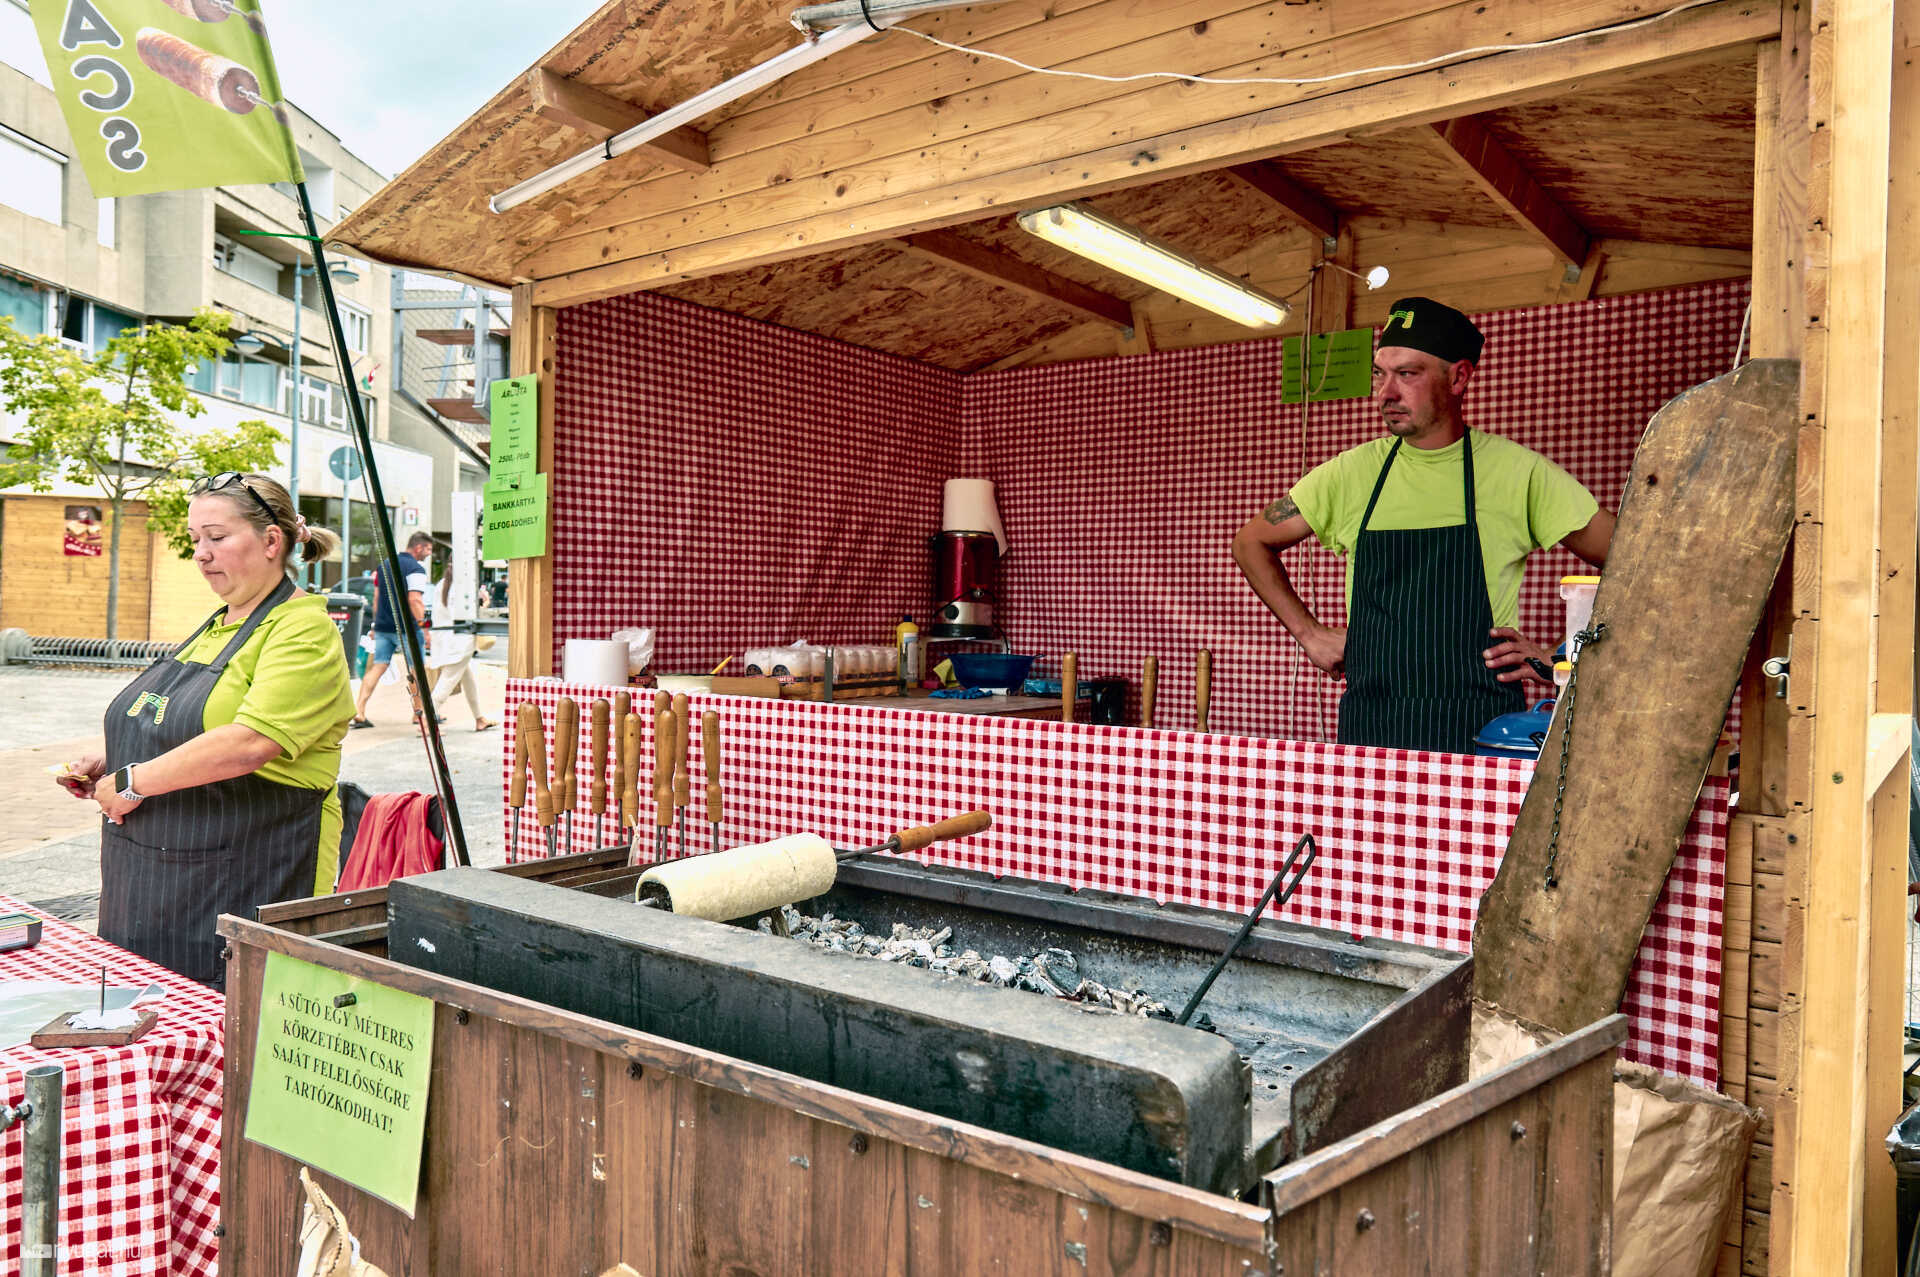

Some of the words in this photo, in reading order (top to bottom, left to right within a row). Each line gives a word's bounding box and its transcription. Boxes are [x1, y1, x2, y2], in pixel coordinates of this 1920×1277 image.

[280, 992, 285, 1006] A
[324, 1005, 352, 1027] EGY
[354, 1015, 414, 1051] MÉTERES
[283, 1019, 367, 1063] KÖRZETÉBEN
[370, 1050, 405, 1078] CSAK
[272, 1043, 311, 1070] SAJÁT
[313, 1057, 411, 1111] FELELŐSSÉGRE
[284, 1074, 393, 1134] TARTÓZKODHAT!
